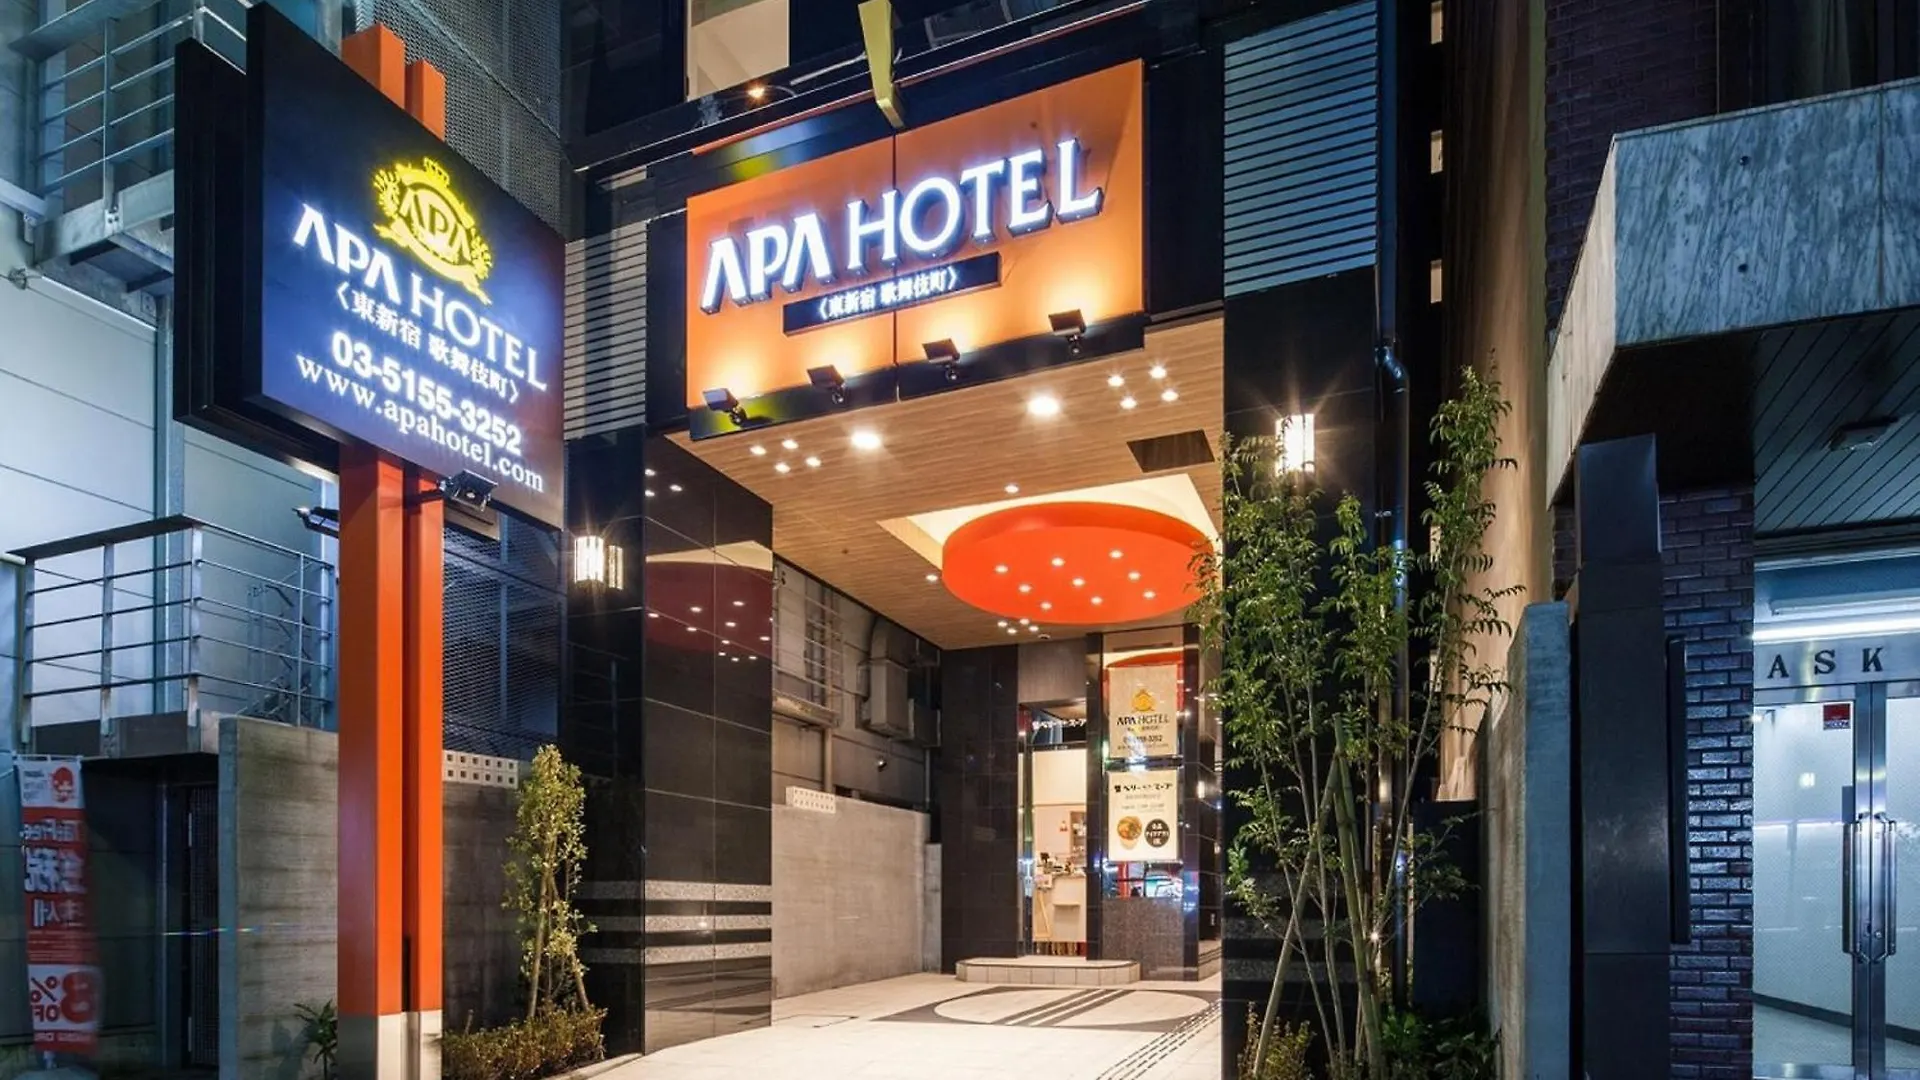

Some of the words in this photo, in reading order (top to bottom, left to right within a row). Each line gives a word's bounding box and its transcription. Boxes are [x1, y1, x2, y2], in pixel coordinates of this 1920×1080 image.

[400, 187, 472, 263] APA
[700, 213, 835, 314] APA
[846, 138, 1103, 274] HOTEL
[293, 203, 401, 305] APA
[410, 271, 547, 391] HOTEL
[296, 354, 545, 493] www.apahotel.com
[331, 330, 522, 456] 03-5155-3252
[1137, 713, 1169, 724] HOTEL
